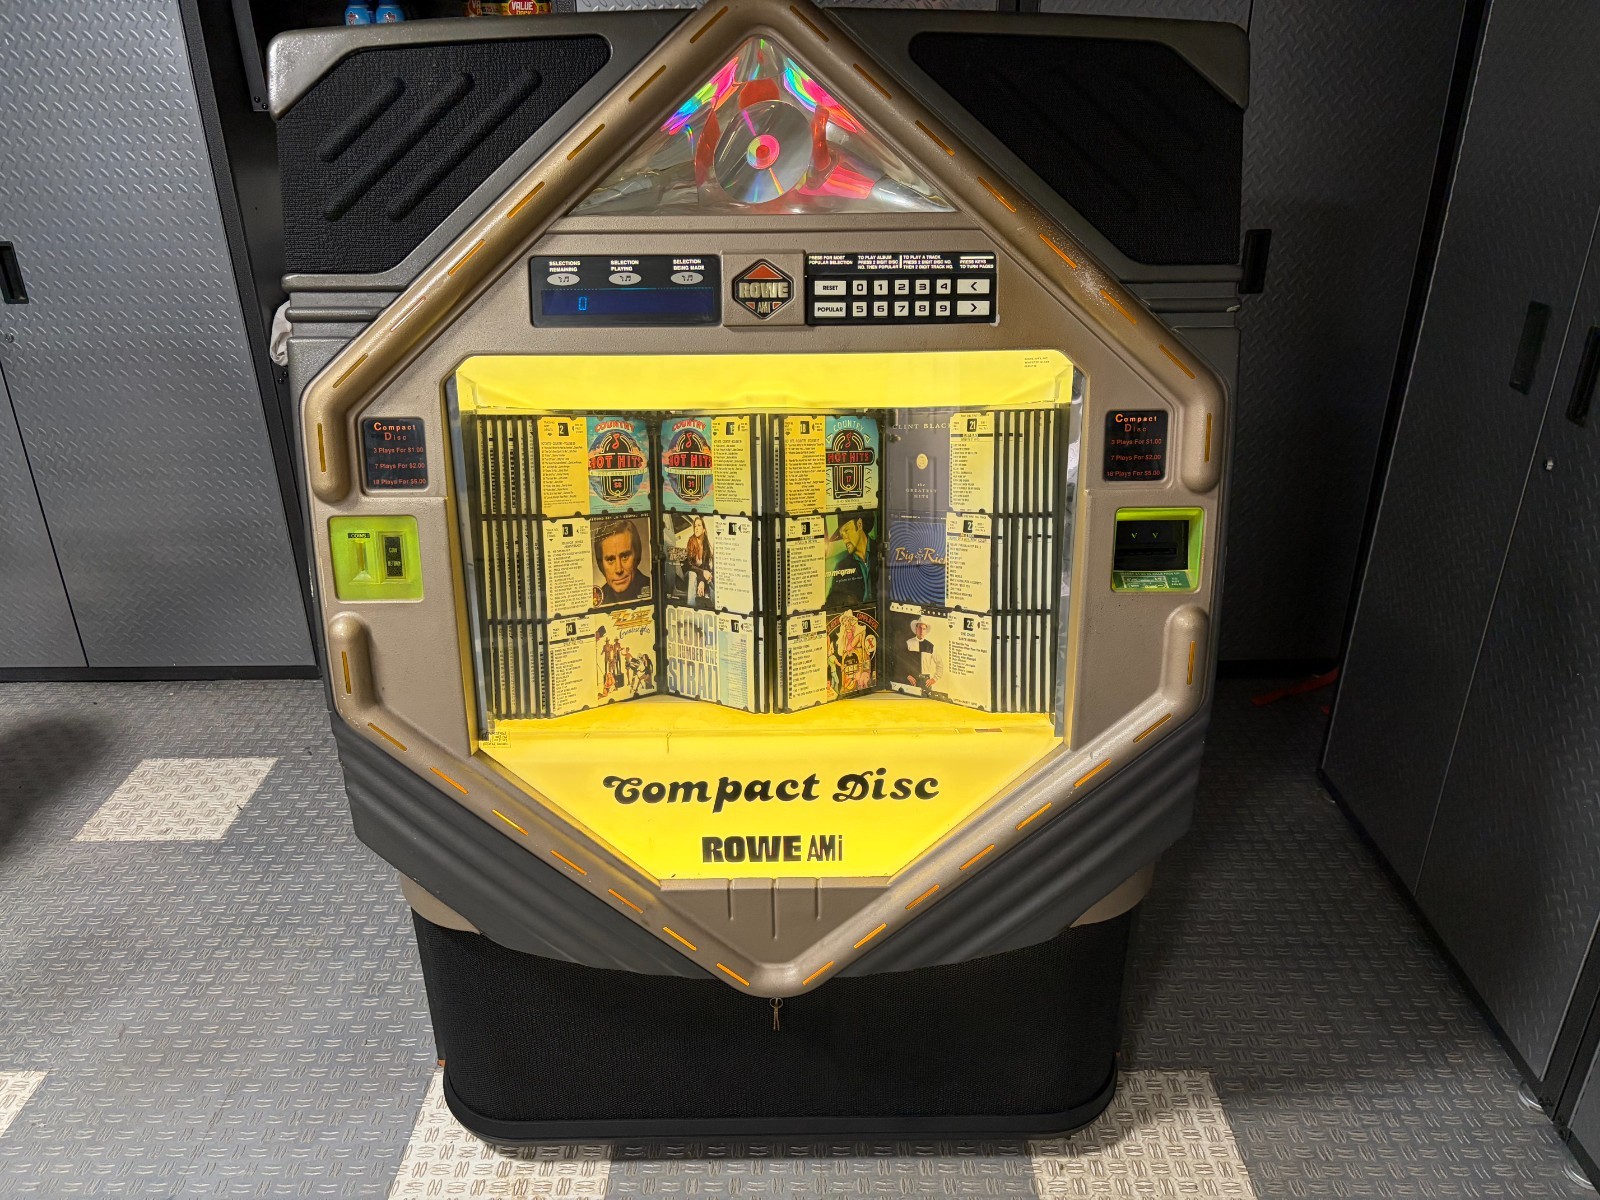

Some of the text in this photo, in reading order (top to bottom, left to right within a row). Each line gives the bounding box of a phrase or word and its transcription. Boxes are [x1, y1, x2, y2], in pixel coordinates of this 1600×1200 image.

[512, 2, 533, 10] VALUE
[739, 282, 789, 298] ROWE
[1115, 414, 1157, 423] Compact
[374, 422, 416, 431] Compact
[595, 420, 635, 432] COUNTRY
[672, 420, 706, 431] COUNTRY
[834, 420, 864, 432] COUNTRY
[969, 420, 976, 429] 21
[1125, 424, 1146, 432] Disc
[384, 432, 406, 440] Disc
[618, 455, 643, 468] HITS
[827, 453, 870, 463] HOT HITS
[895, 547, 914, 563] Big
[832, 568, 856, 577] mcgraw
[678, 644, 704, 662] NUMBER
[668, 657, 718, 702] STRAIT
[602, 767, 940, 814] Compact Disc
[701, 835, 801, 863] ROWE
